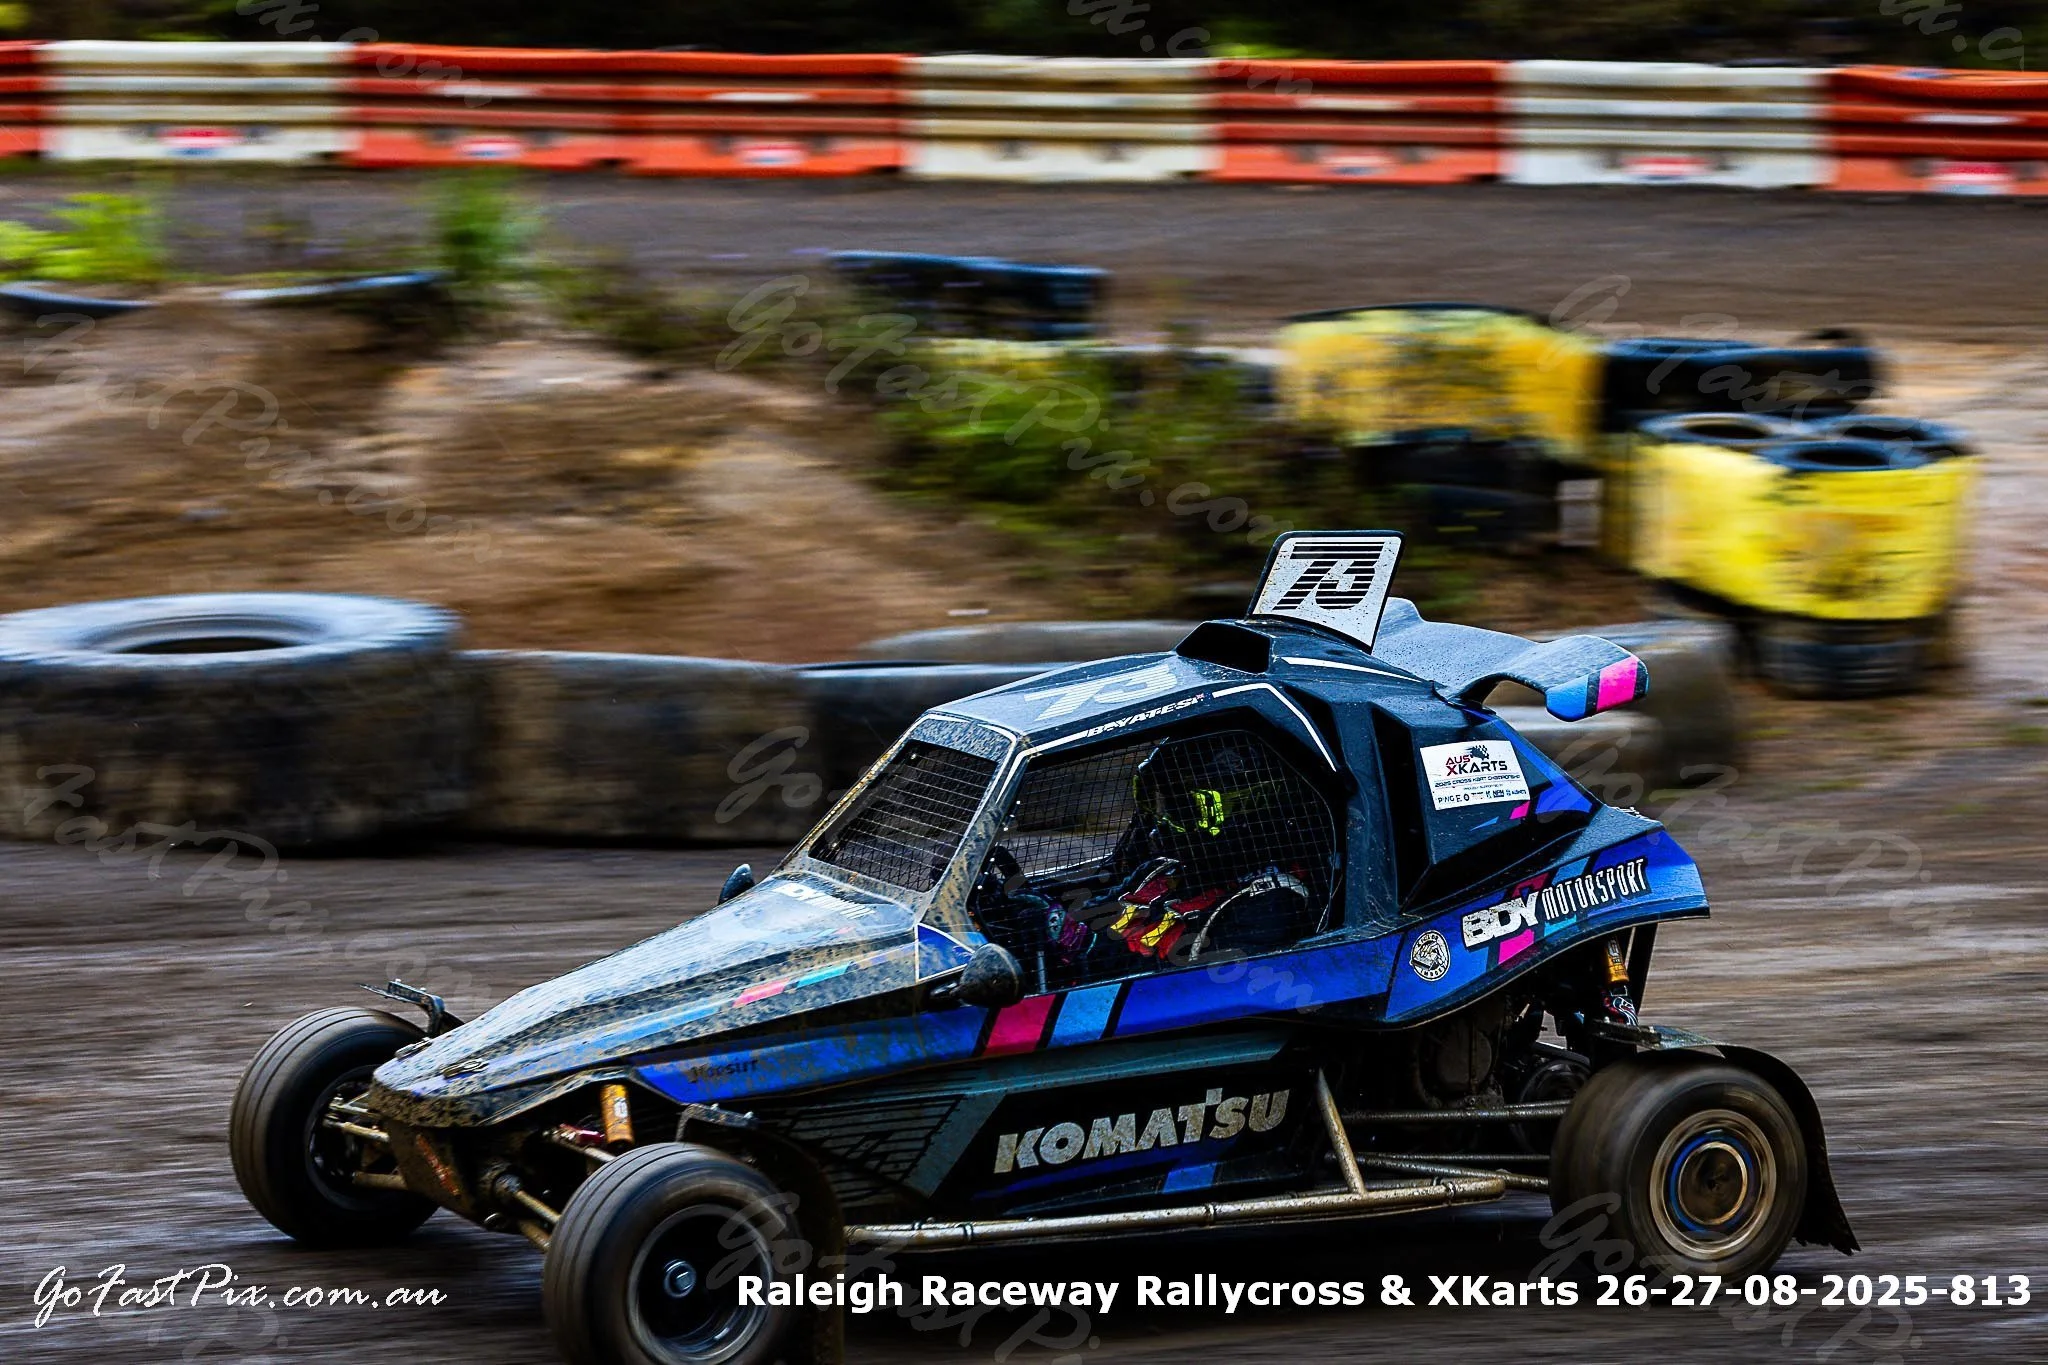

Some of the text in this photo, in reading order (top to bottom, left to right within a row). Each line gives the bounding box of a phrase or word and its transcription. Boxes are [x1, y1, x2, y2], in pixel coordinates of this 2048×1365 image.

[1272, 541, 1385, 610] 73
[1024, 664, 1178, 722] 73
[1446, 755, 1471, 766] AUS
[1446, 760, 1508, 777] XKARTS
[1462, 858, 1648, 948] BDY MOTORSPORT
[993, 1087, 1291, 1174] KOMATSU
